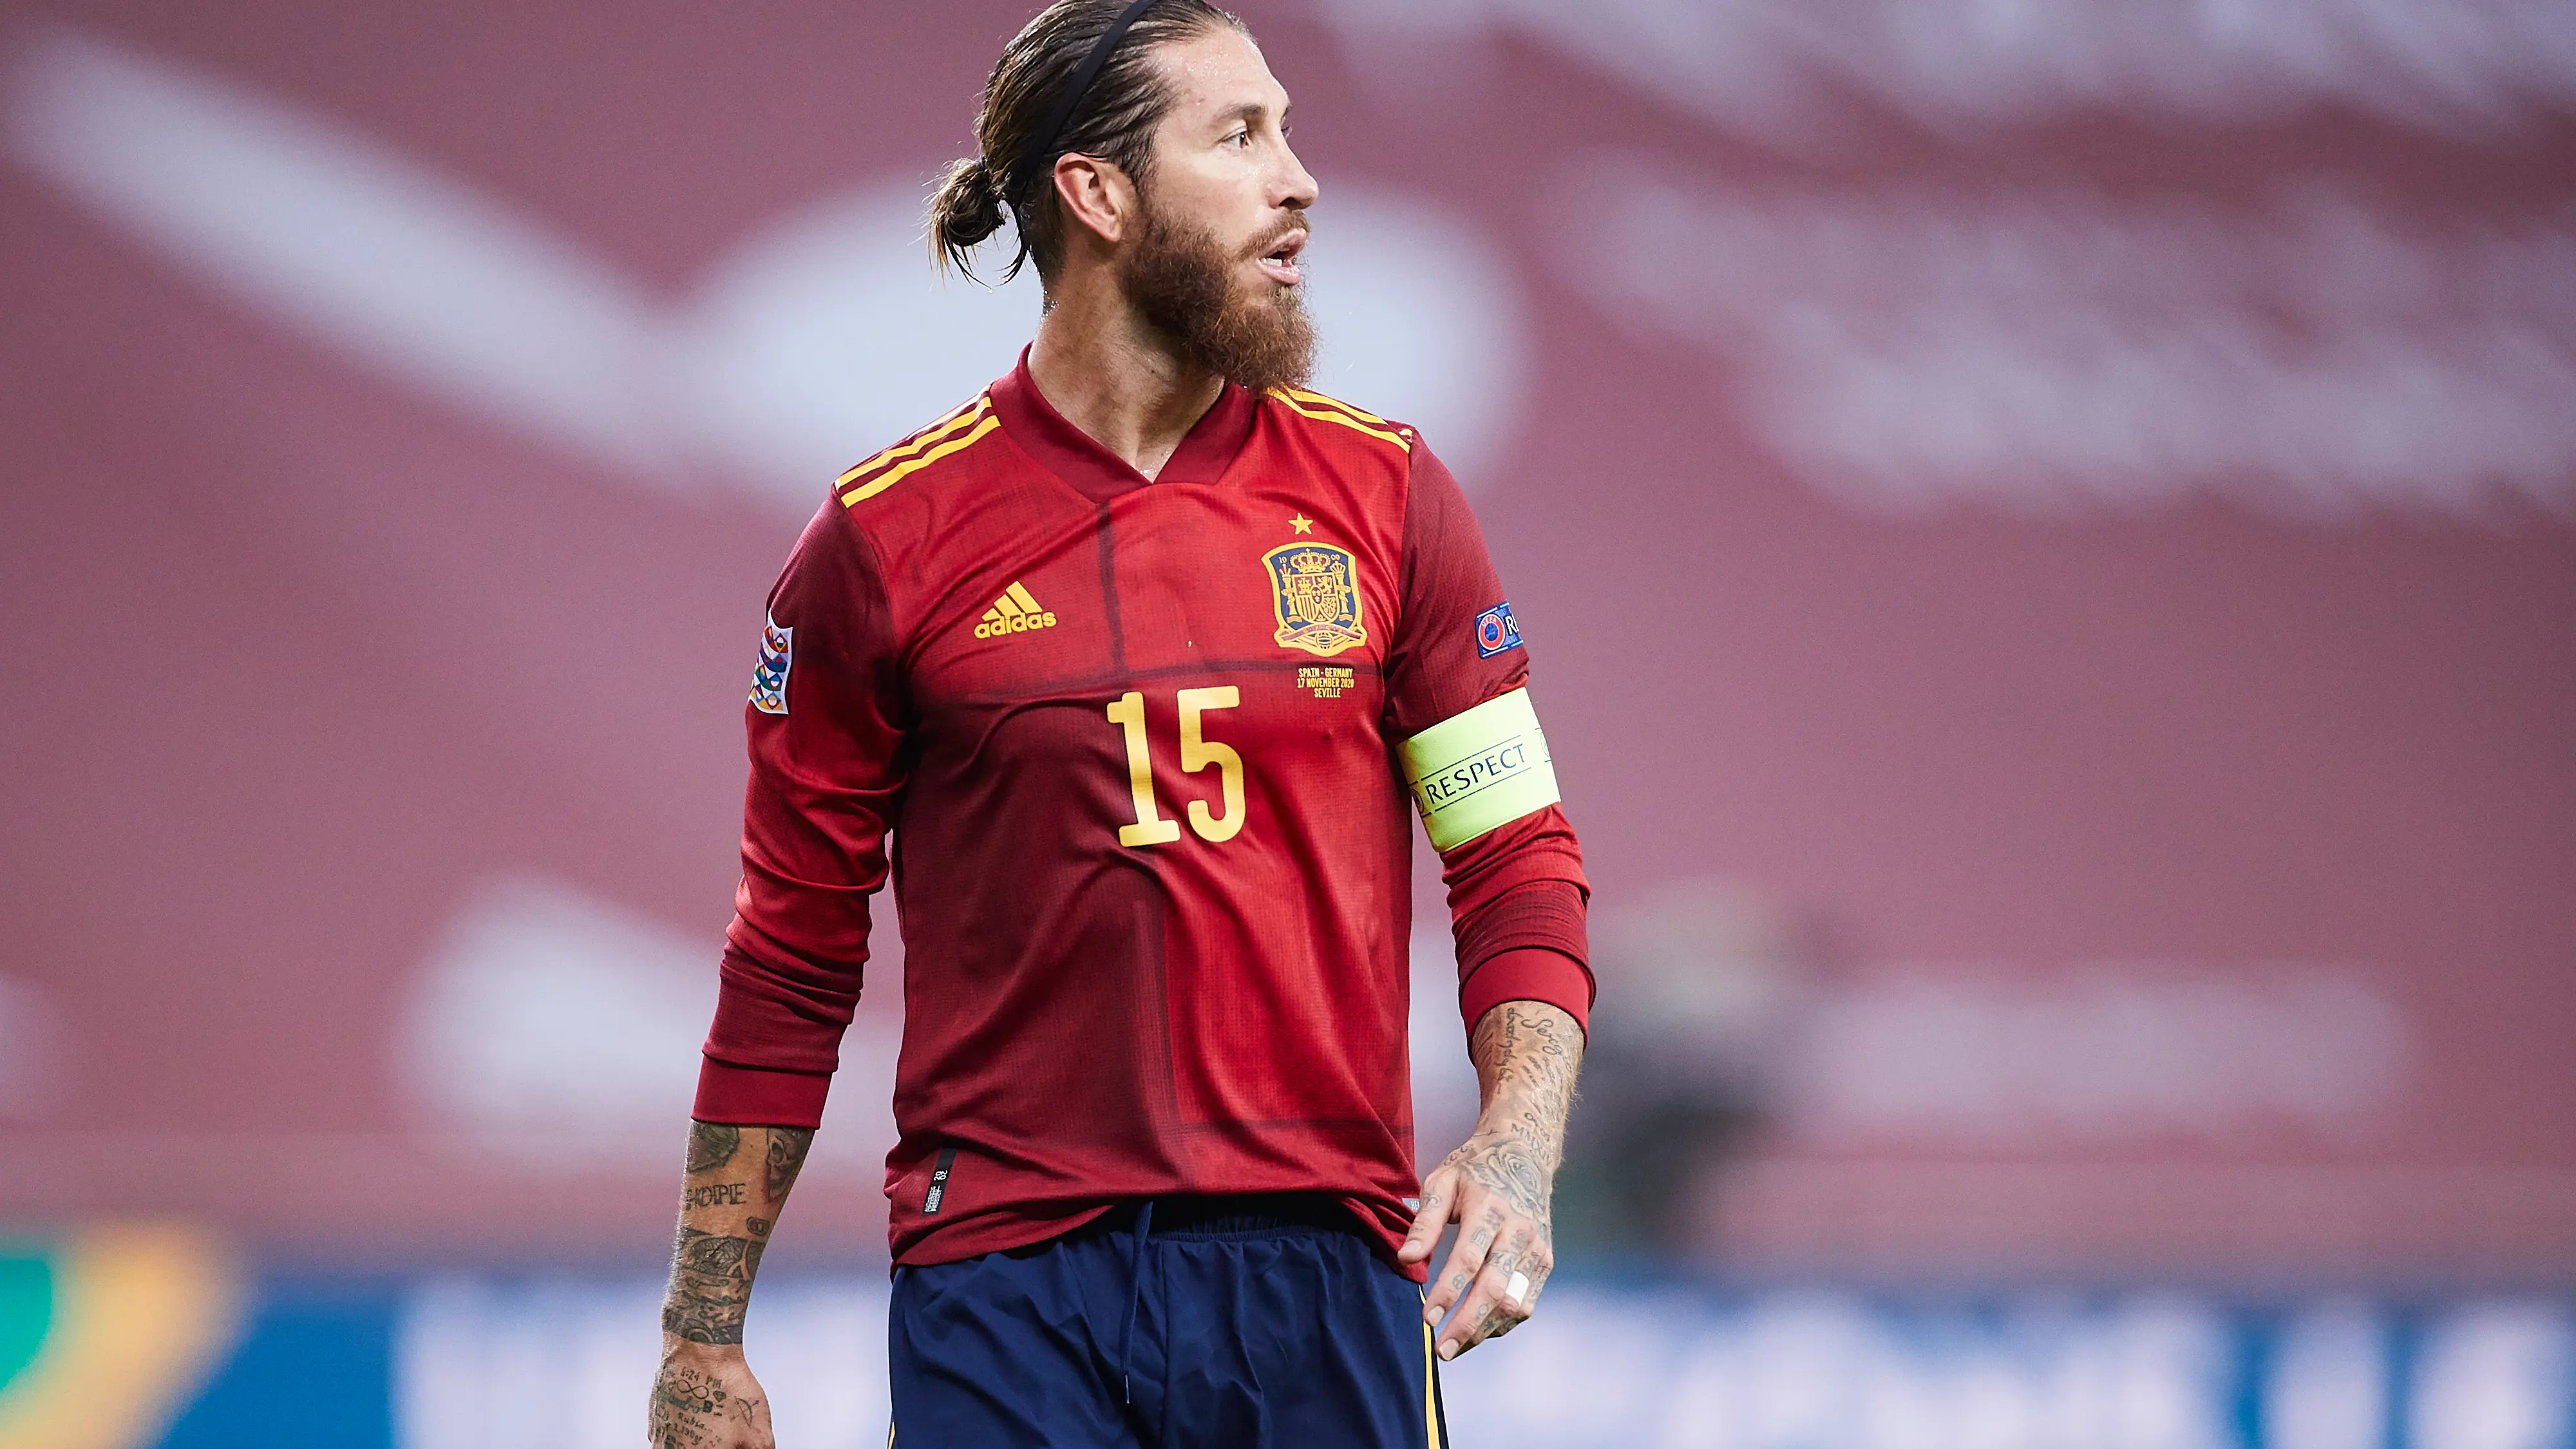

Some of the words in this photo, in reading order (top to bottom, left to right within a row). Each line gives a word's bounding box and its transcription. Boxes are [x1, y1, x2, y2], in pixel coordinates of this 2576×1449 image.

[974, 611, 1057, 639] adidas
[1482, 616, 1497, 627] UEFA
[1298, 667, 1320, 678] SPAIN
[1325, 667, 1353, 678] GERMANY
[1297, 677, 1305, 688] 17
[1306, 677, 1340, 688] NOVEMBER
[1340, 678, 1354, 688] 2020
[1314, 687, 1341, 698] SEVILLE
[1106, 685, 1245, 848] 15
[1425, 743, 1524, 804] RESPECT
[686, 1182, 746, 1211] HOPE
